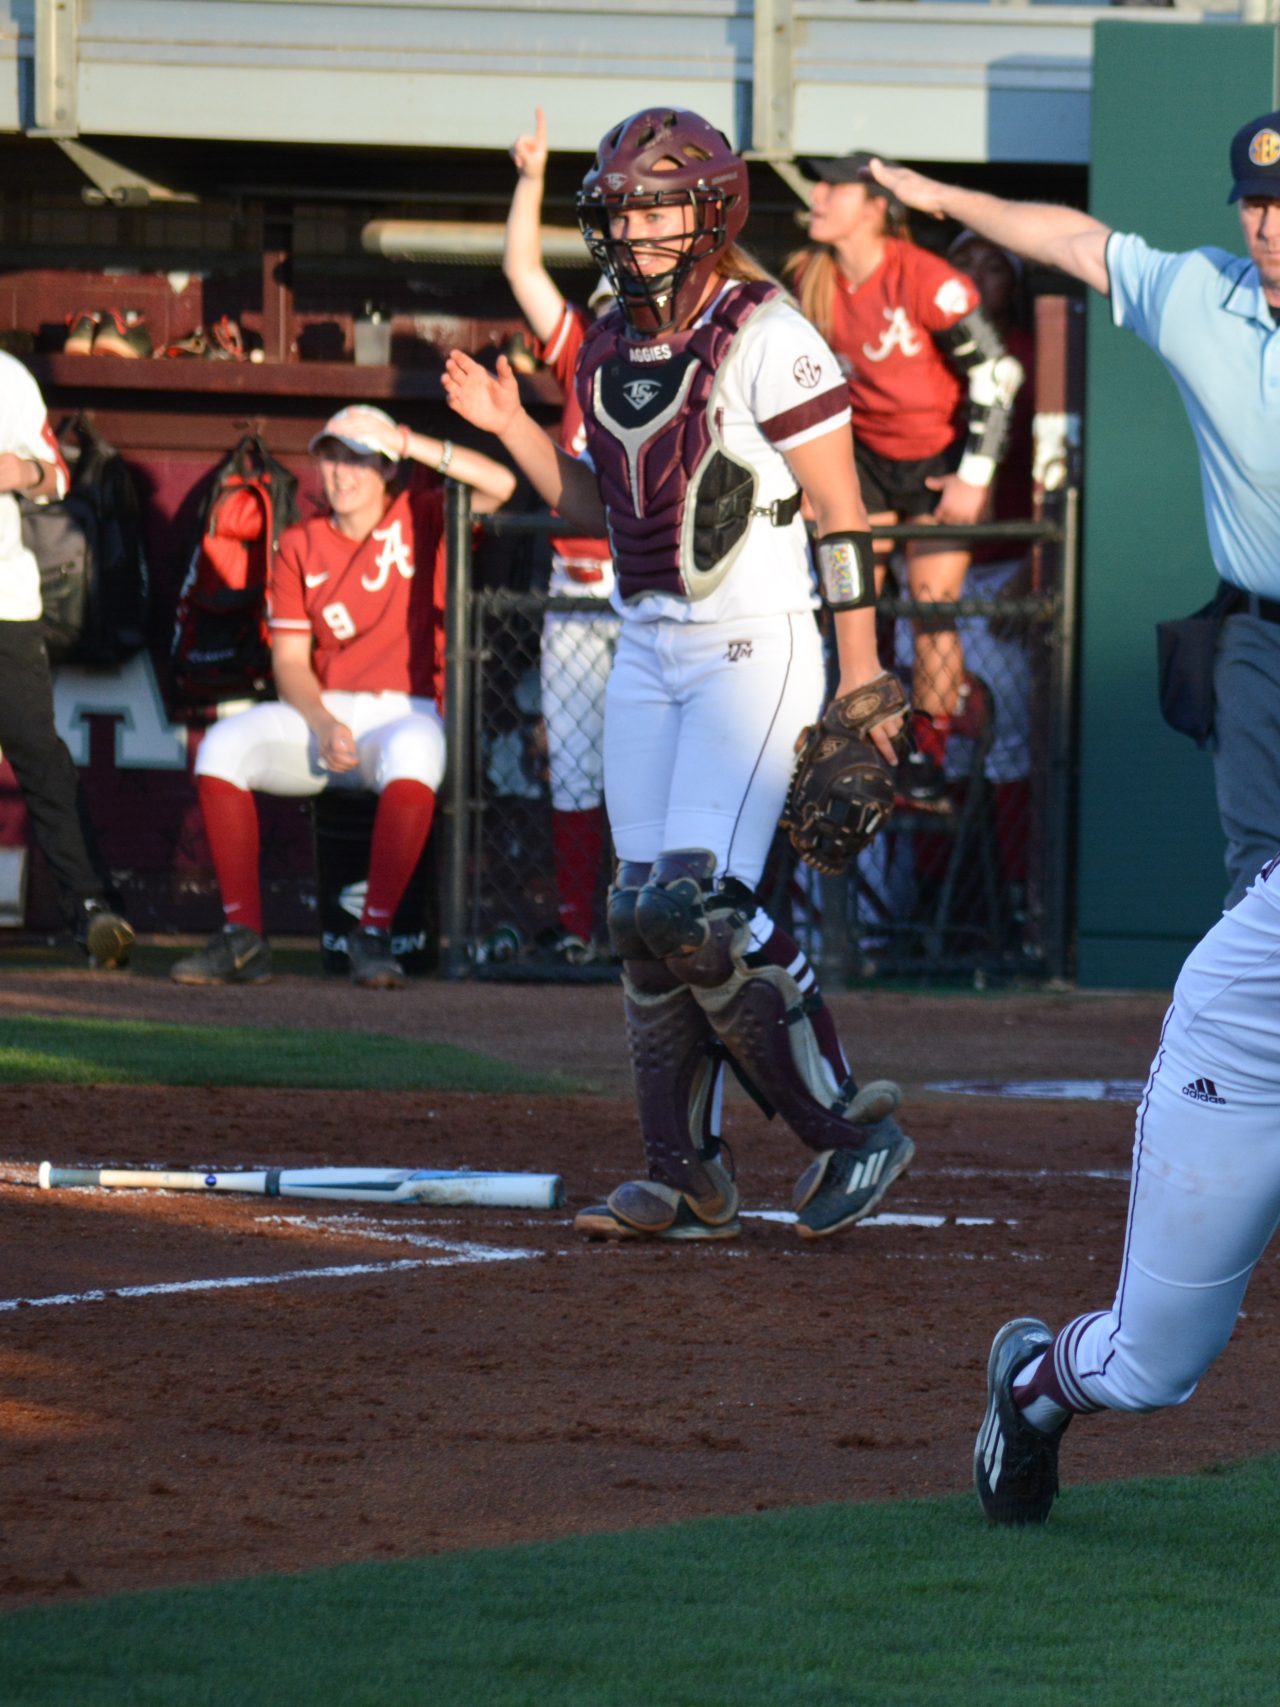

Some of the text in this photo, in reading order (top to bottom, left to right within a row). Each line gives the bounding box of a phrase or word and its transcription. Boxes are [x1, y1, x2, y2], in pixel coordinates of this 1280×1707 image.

[863, 306, 922, 362] A
[630, 344, 672, 363] AGGIES
[361, 519, 415, 592] A
[322, 602, 356, 640] 9
[322, 930, 427, 955] EAON
[1182, 1086, 1227, 1105] adidas
